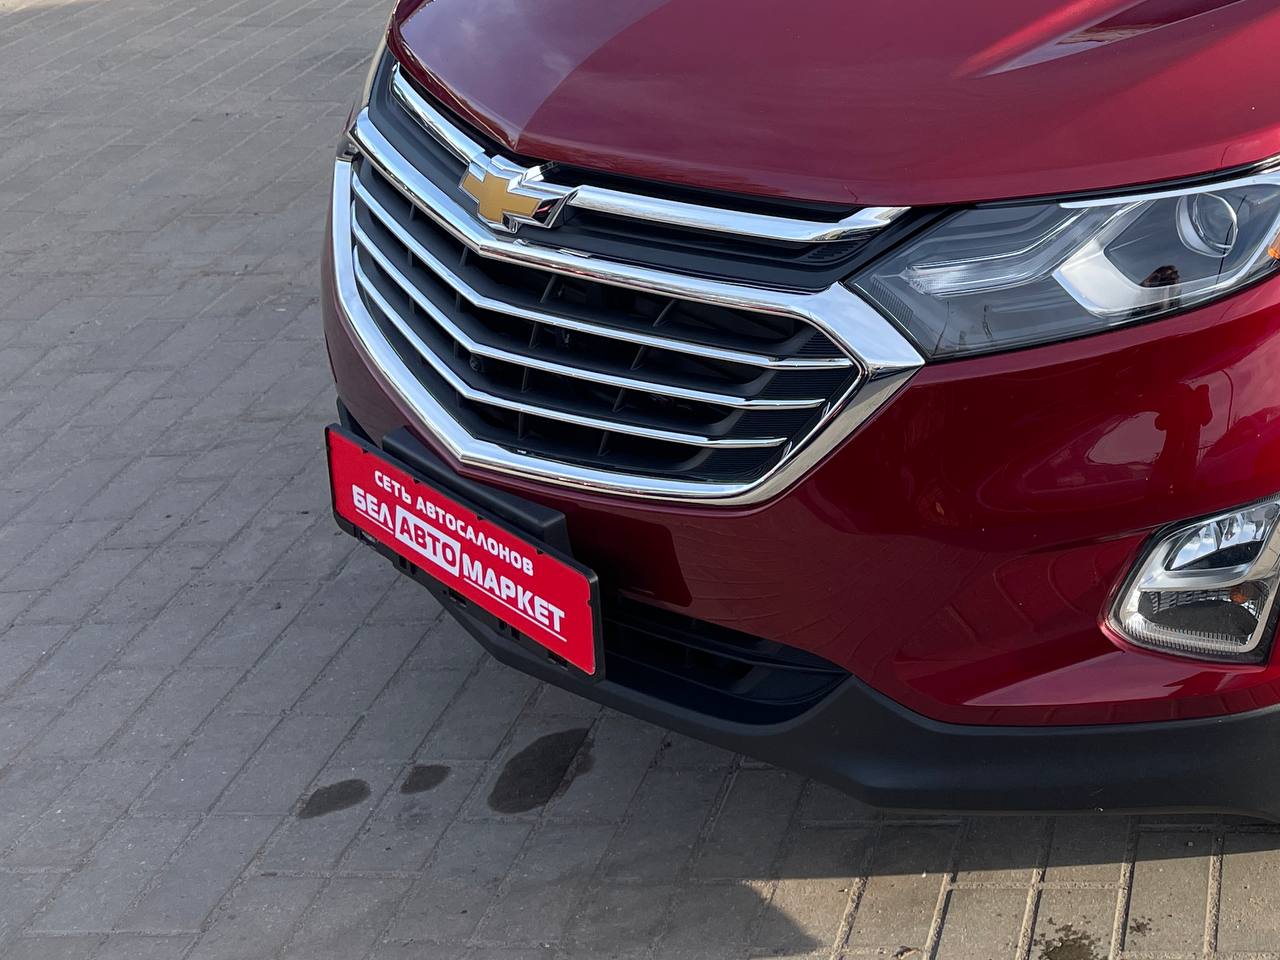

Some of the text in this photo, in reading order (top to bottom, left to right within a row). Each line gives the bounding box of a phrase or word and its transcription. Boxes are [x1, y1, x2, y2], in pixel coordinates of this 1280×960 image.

[351, 484, 566, 633] БЕЛ АВТО МАРКЕТ
[373, 470, 534, 577] СЕТЬ АВТОСАЛОНОВ
